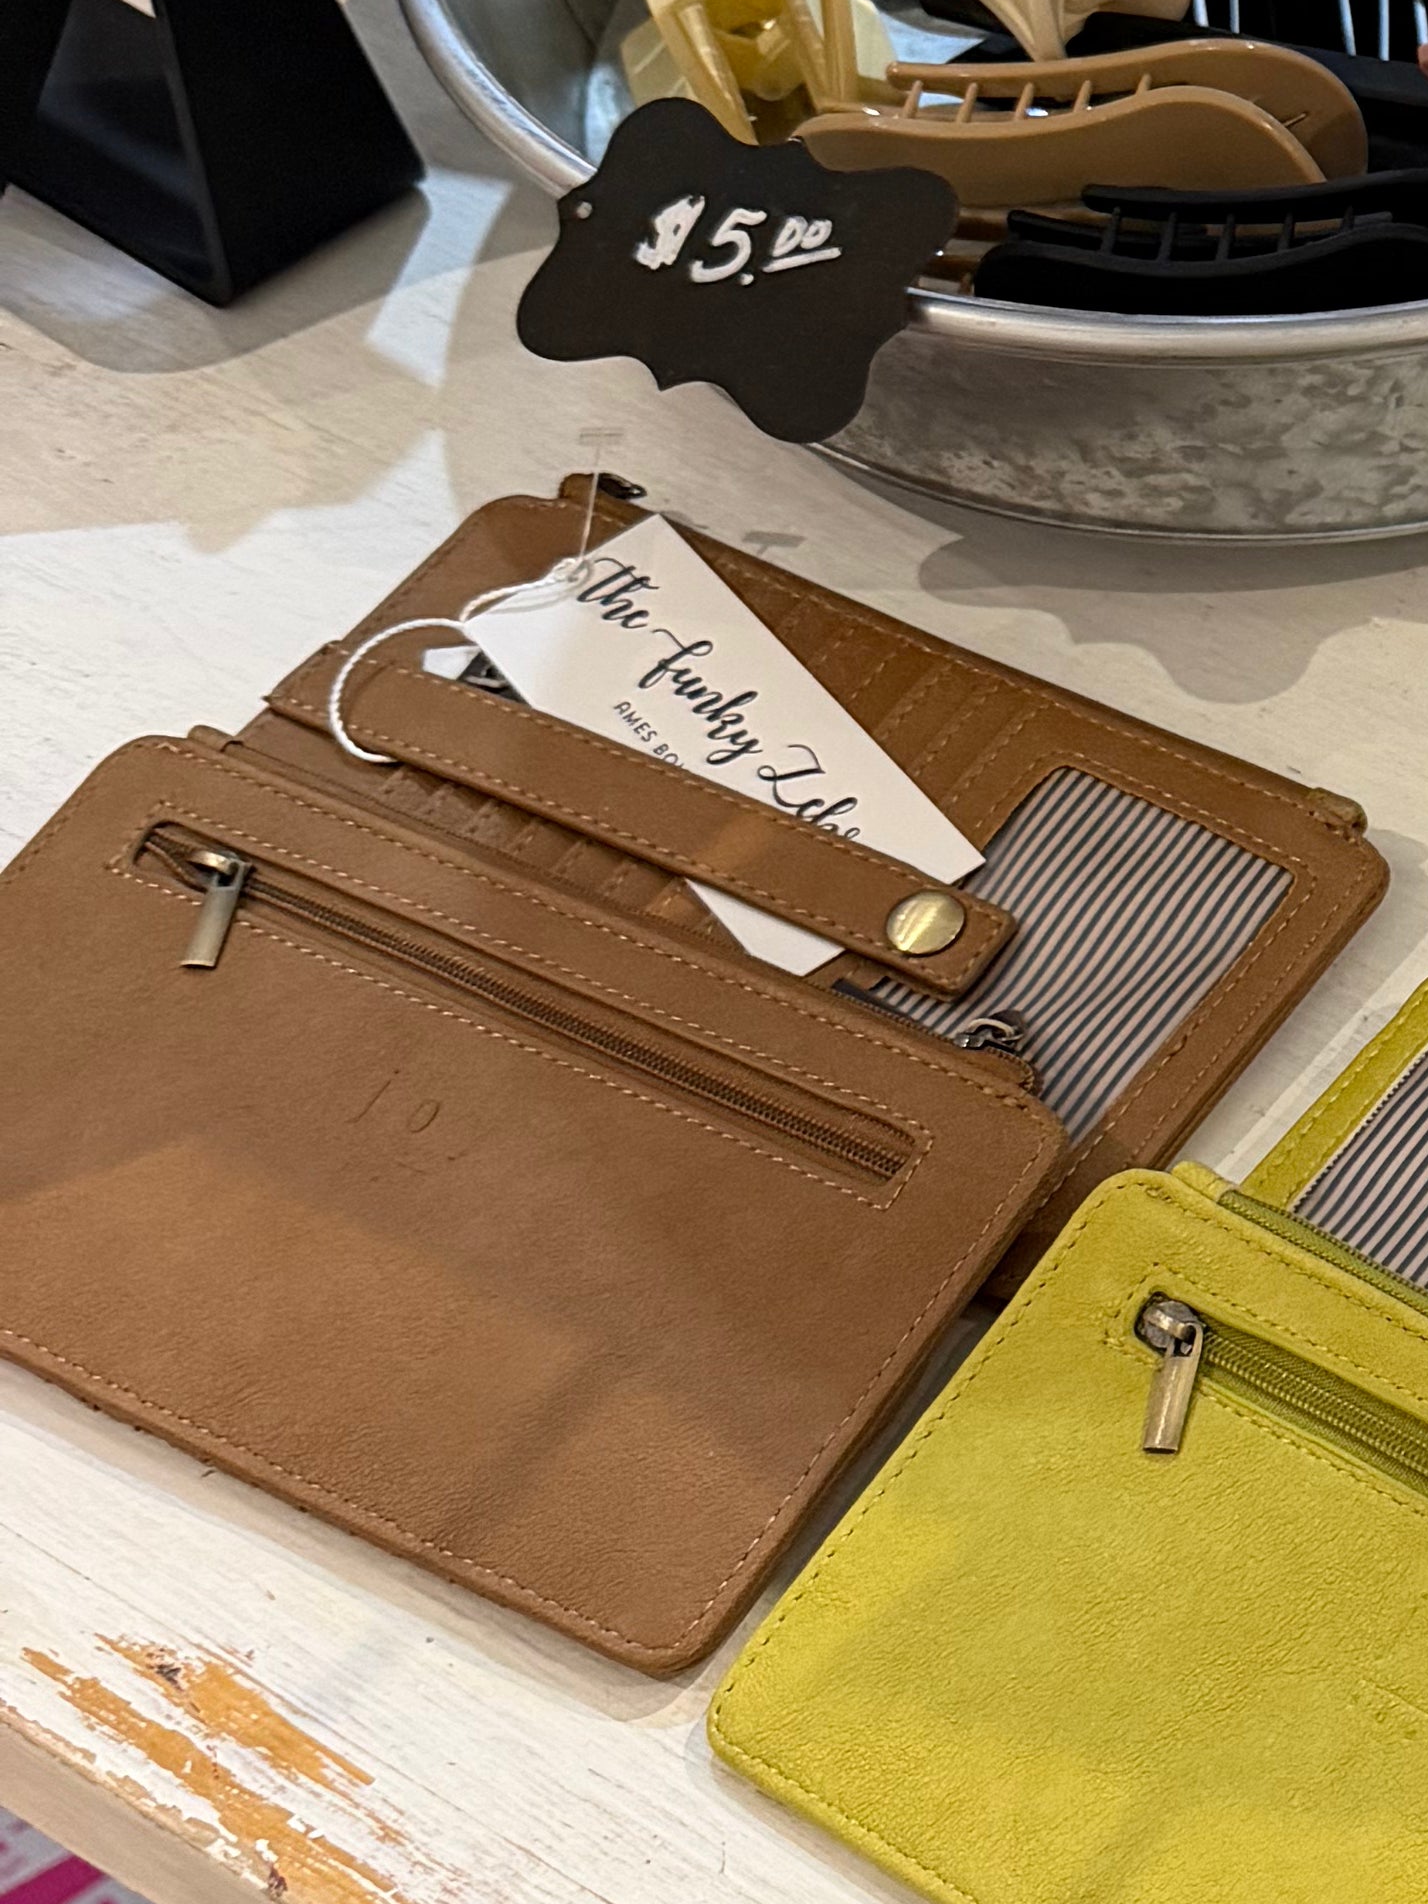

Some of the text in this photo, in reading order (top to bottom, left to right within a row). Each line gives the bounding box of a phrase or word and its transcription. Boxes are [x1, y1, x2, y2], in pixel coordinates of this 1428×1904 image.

[574, 557, 660, 630] the
[653, 628, 764, 767] funky
[613, 701, 658, 742] AMES
